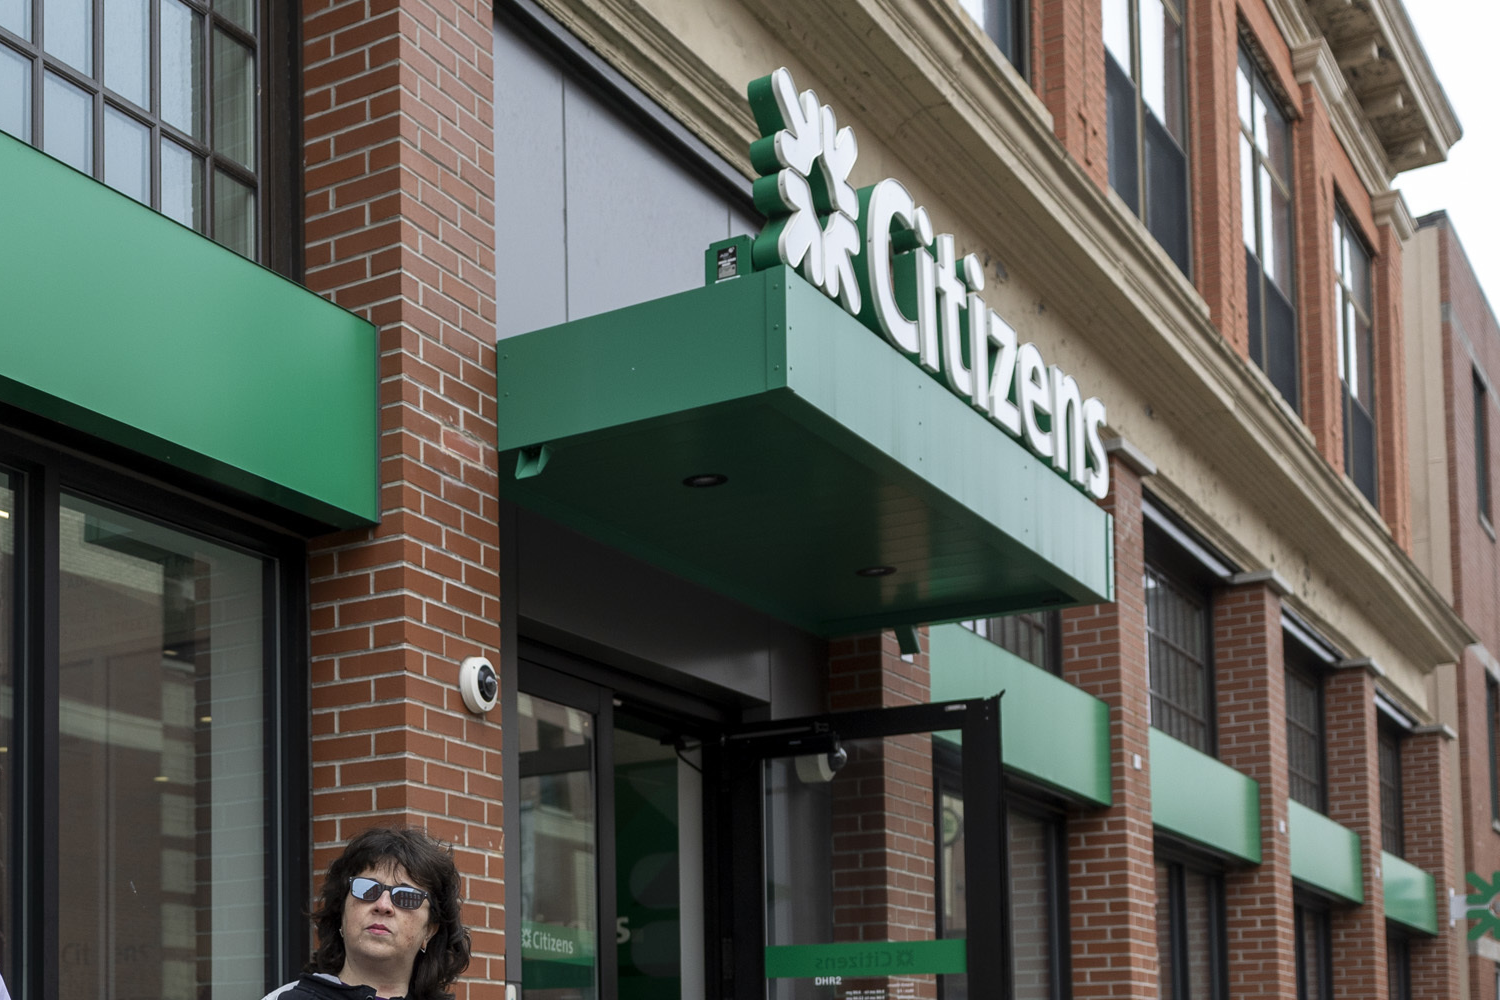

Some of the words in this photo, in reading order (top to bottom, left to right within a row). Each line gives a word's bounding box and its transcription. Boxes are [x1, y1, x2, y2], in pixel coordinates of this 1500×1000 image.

[866, 177, 1110, 500] Citizens
[533, 931, 574, 955] Citizens
[814, 975, 842, 986] DHR2
